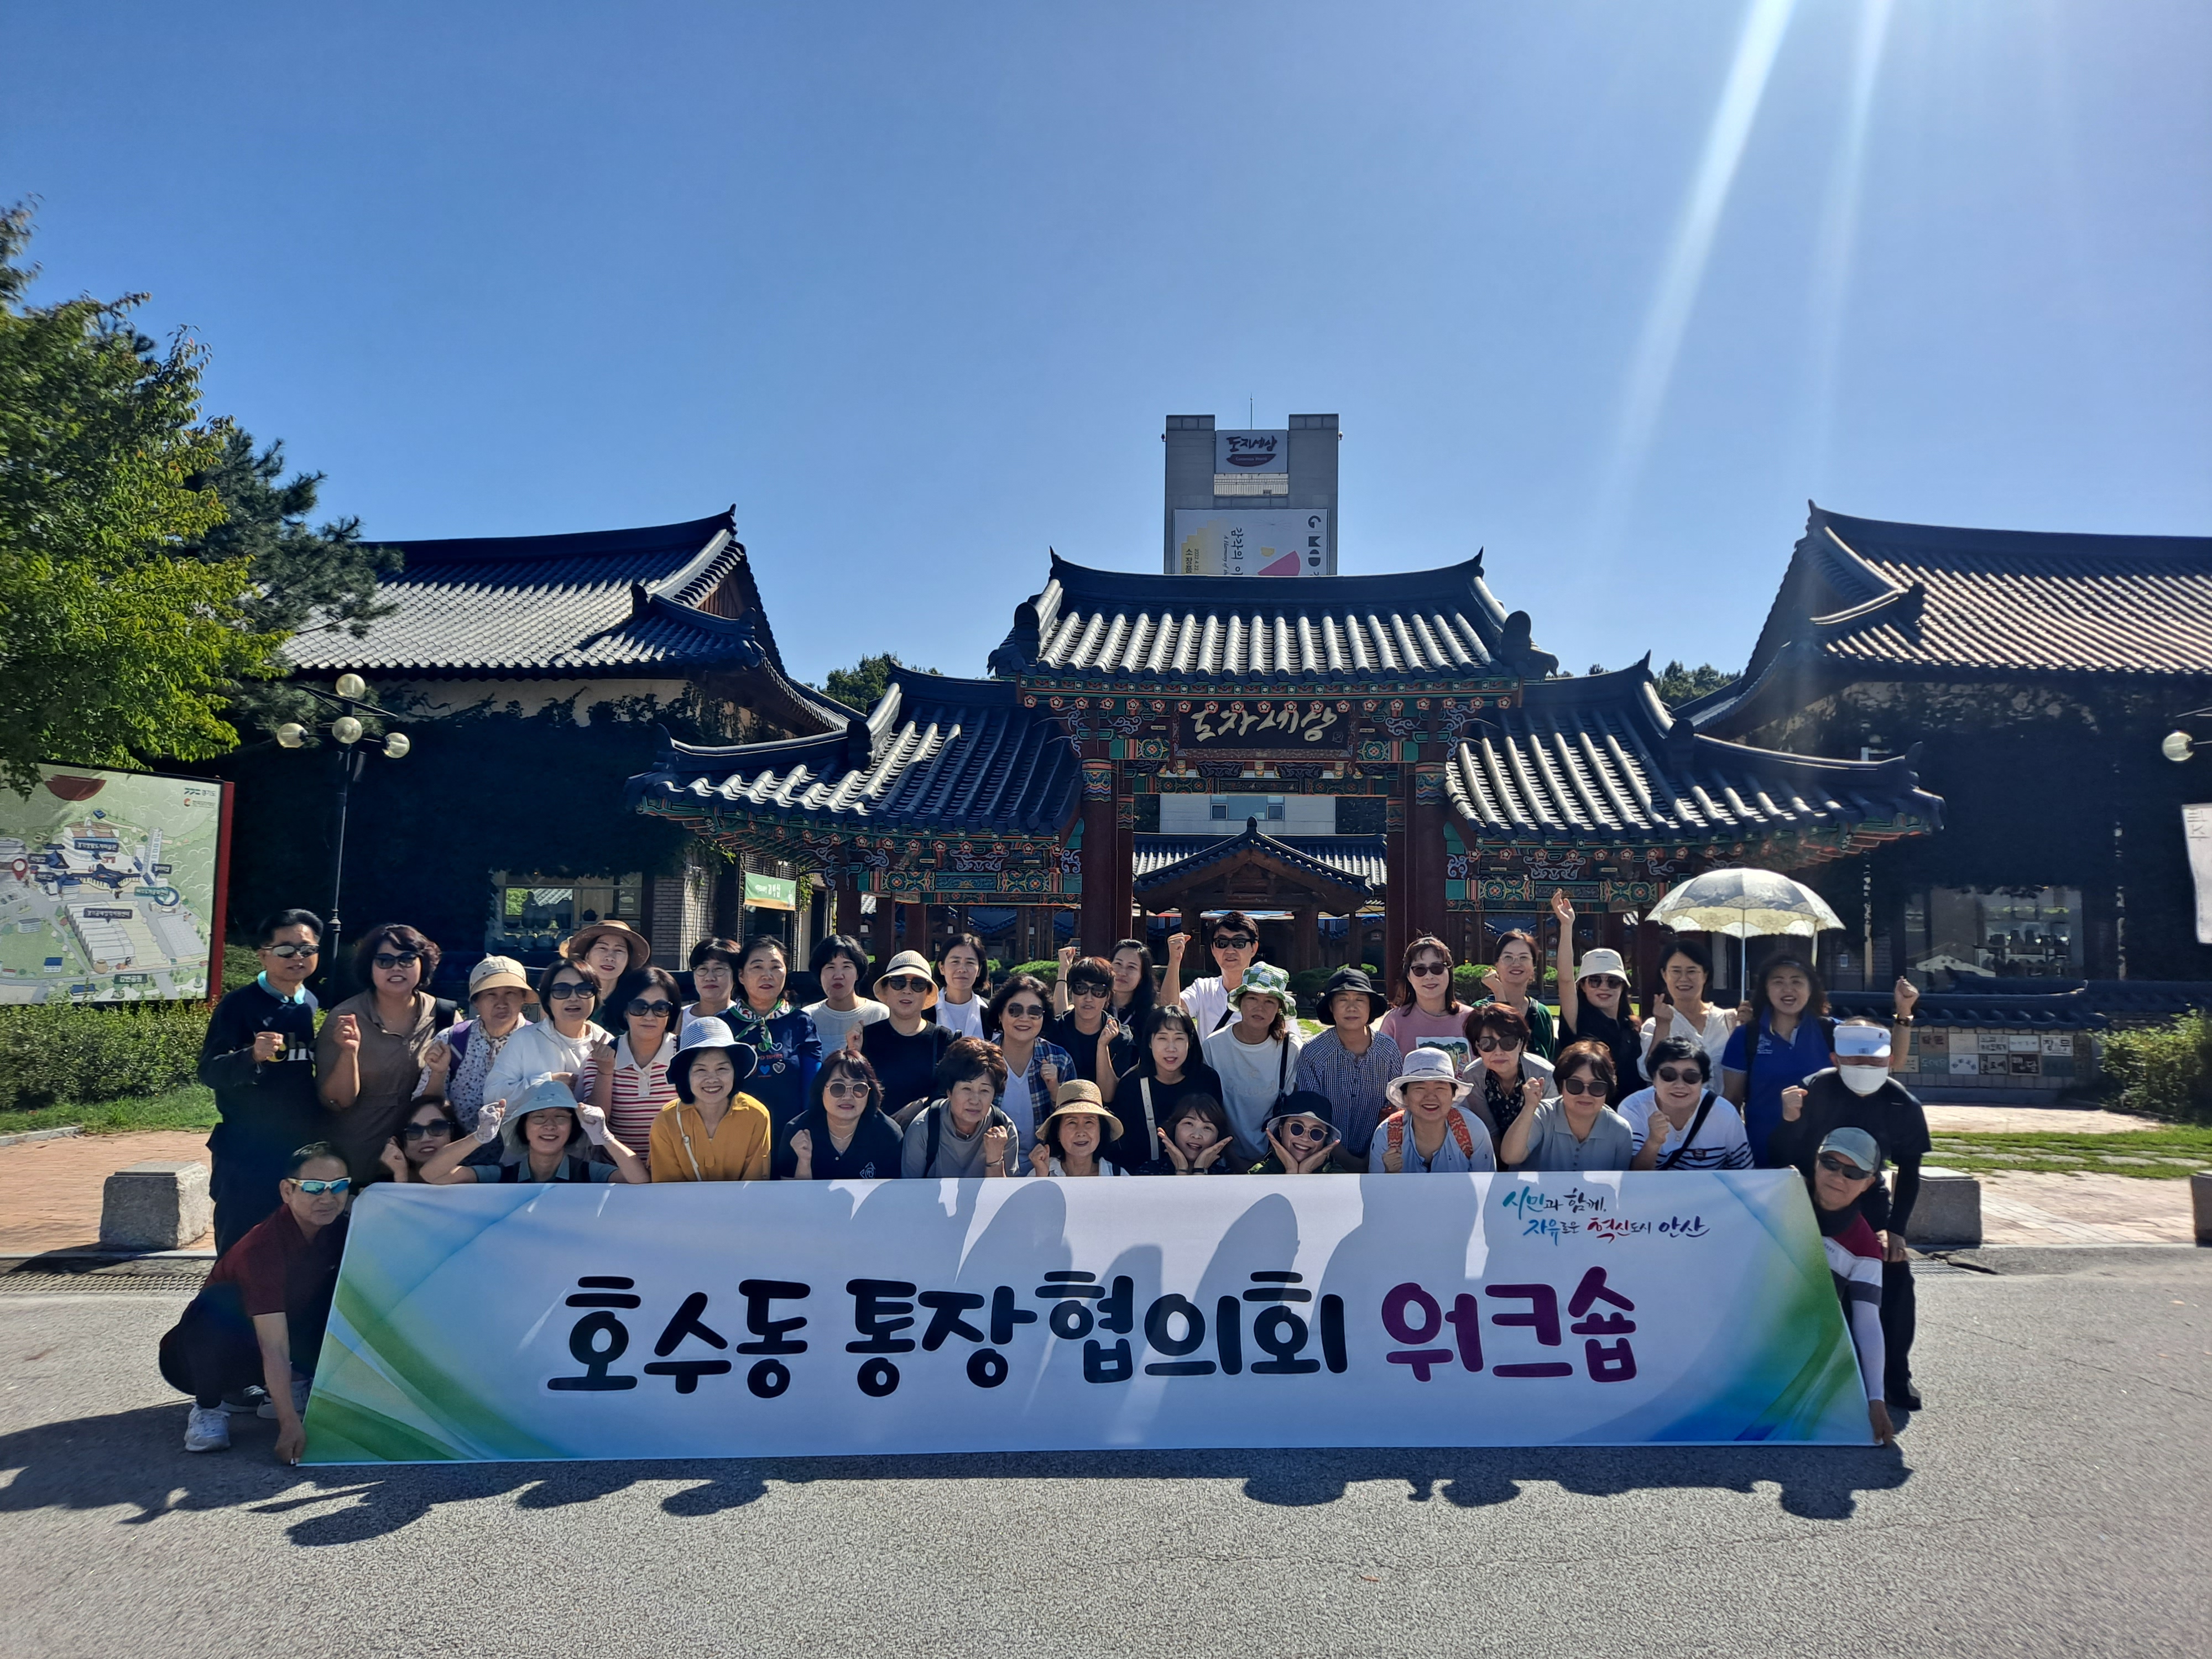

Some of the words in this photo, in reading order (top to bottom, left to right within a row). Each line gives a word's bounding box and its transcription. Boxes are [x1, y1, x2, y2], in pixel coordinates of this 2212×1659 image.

[1231, 527, 1244, 560] 감각의
[1191, 707, 1338, 742] 도자세상
[1503, 1186, 1564, 1220] 시민과
[1522, 1218, 1581, 1246] 자유로운
[1587, 1217, 1652, 1244] 혁신도시
[1658, 1215, 1711, 1238] 안산
[547, 1275, 811, 1399] 호수동
[845, 1271, 1348, 1397] 통장협의회
[1381, 1266, 1637, 1383] 워크숍
